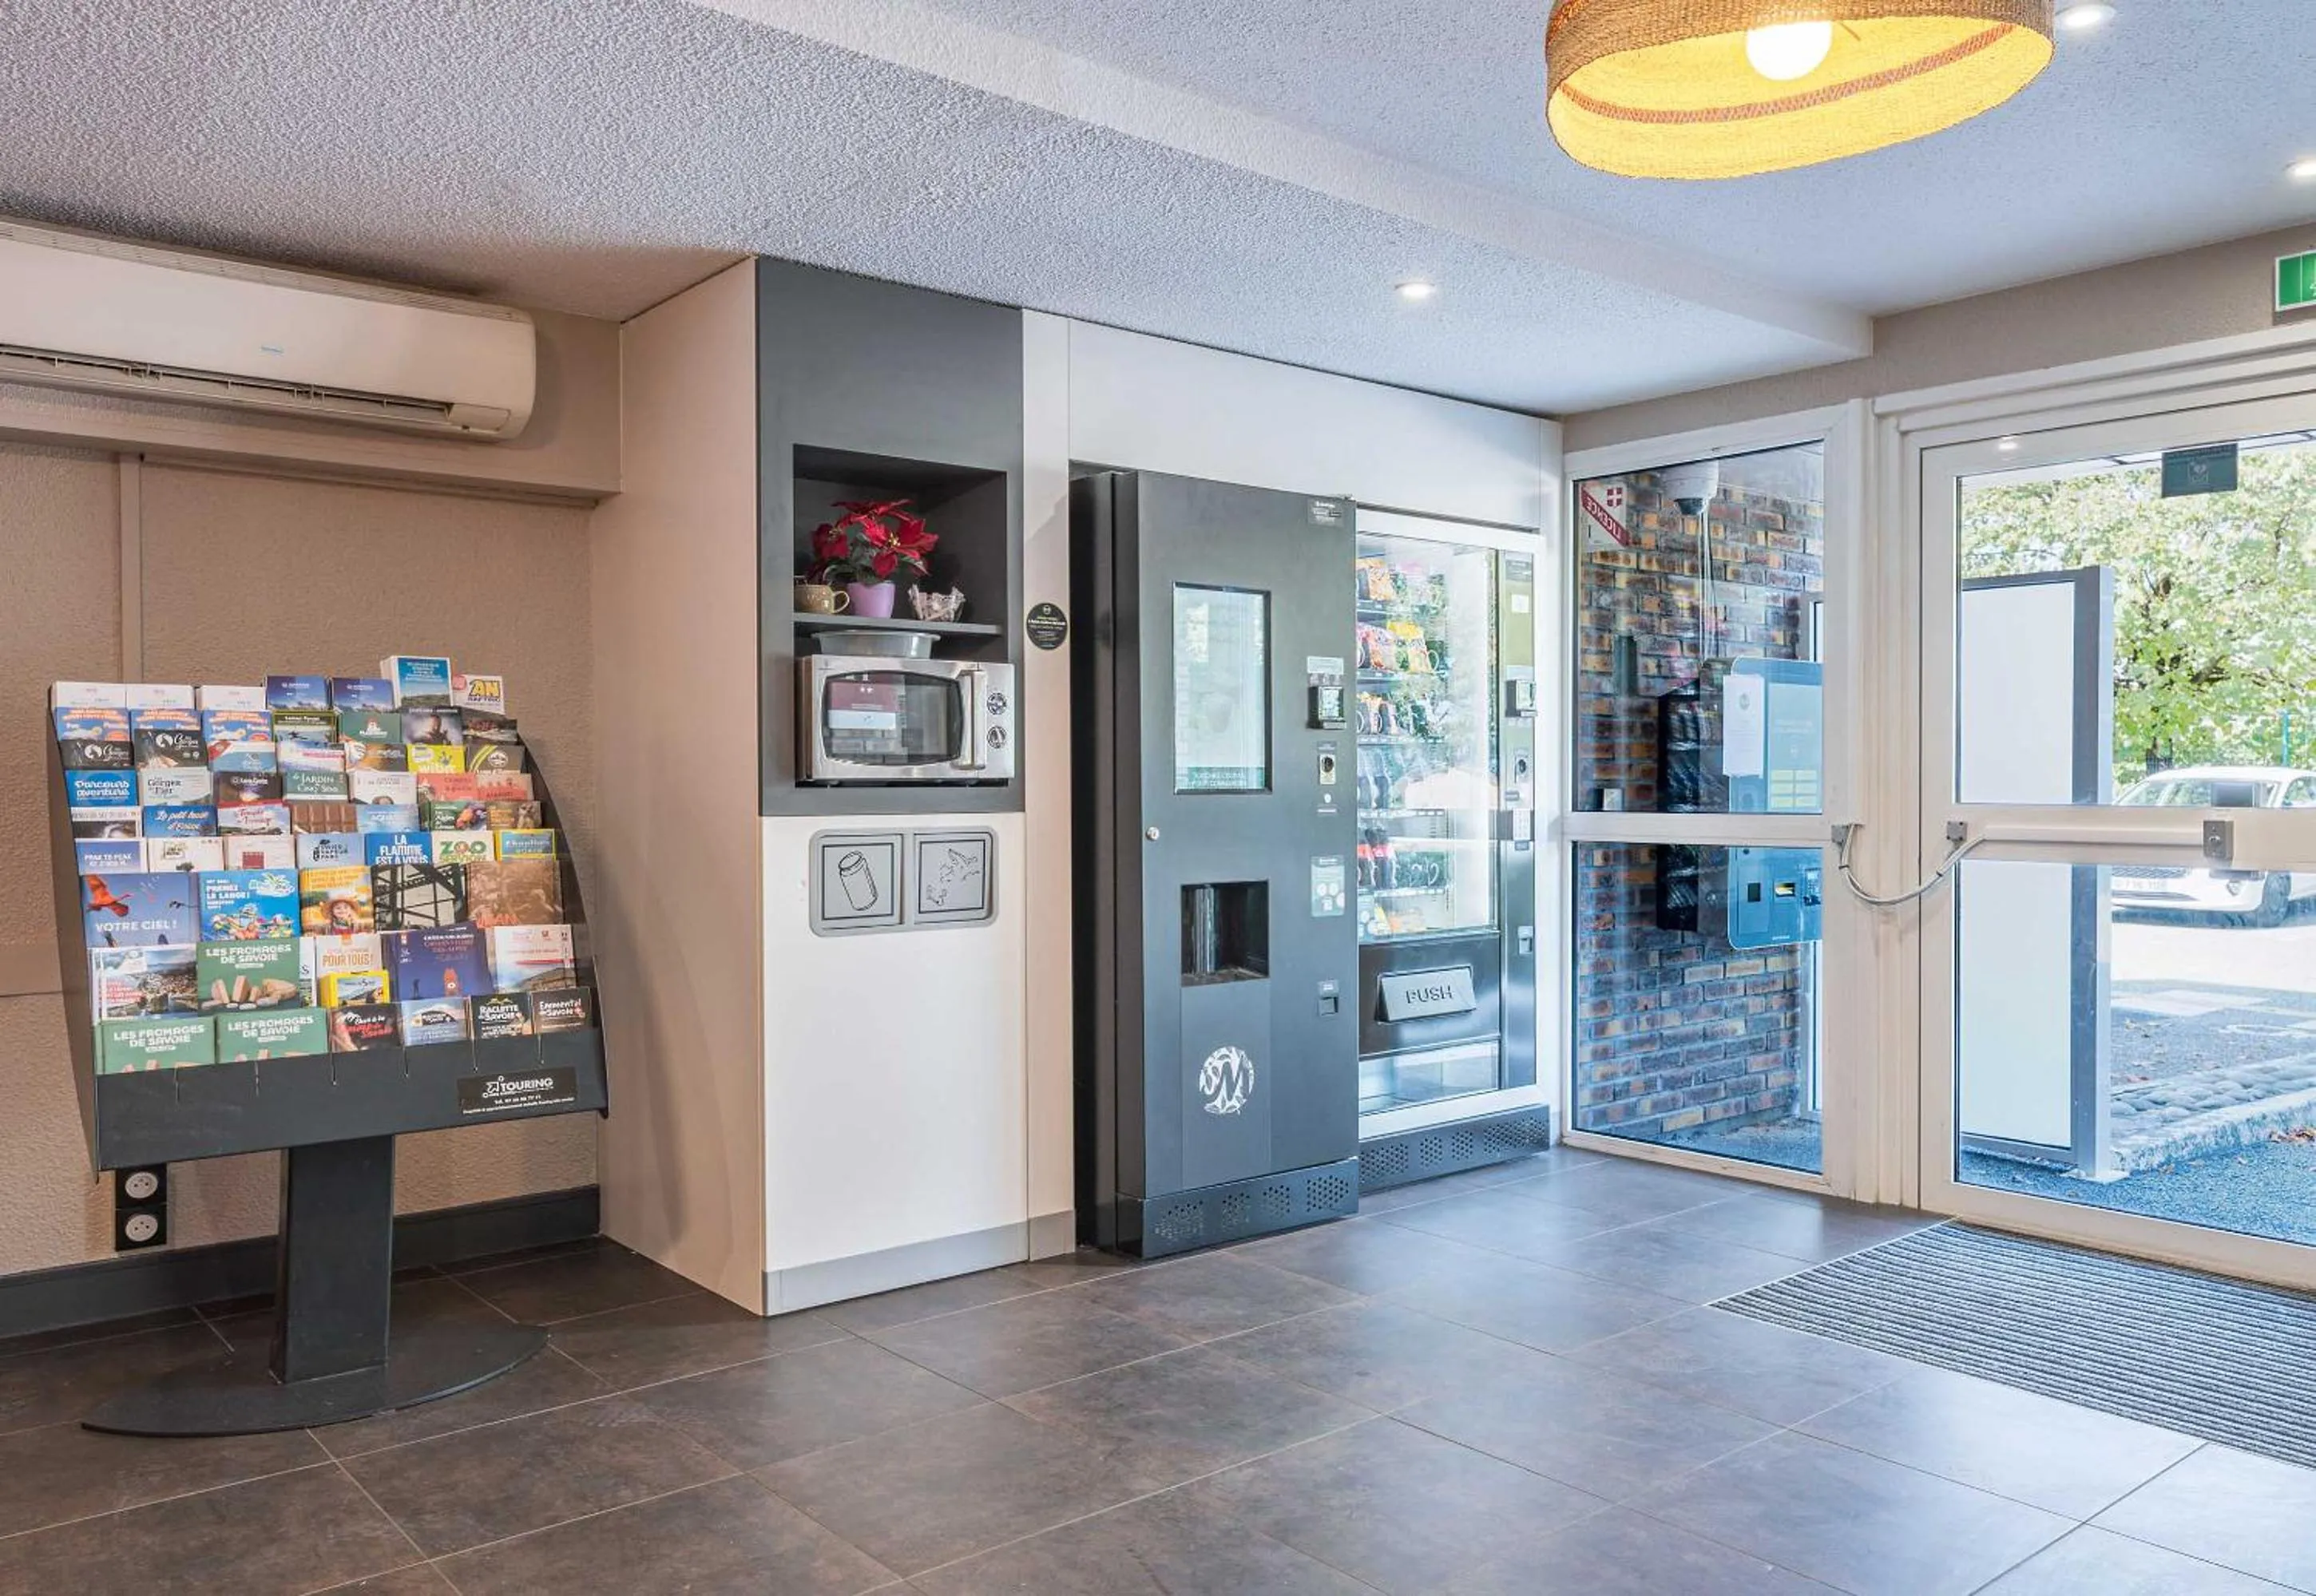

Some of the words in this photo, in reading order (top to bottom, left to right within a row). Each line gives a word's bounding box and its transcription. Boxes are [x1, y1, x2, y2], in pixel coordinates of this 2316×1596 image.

[395, 835, 407, 845] LA
[440, 841, 487, 853] ZOO
[96, 922, 138, 932] VOTRE
[206, 948, 222, 956] LES
[224, 944, 291, 956] FROMAGES
[239, 953, 279, 963] SAVOIE
[1406, 984, 1453, 1004] PUSH
[228, 1022, 249, 1032] LES
[252, 1016, 314, 1028] FROMAGES
[113, 1031, 136, 1041] LES
[139, 1024, 204, 1038] FROMAGES
[243, 1029, 258, 1038] DE
[260, 1026, 301, 1036] SAVOIE
[129, 1039, 145, 1047] DE
[148, 1036, 191, 1047] SAVOIE
[500, 1077, 553, 1092] TOURING
